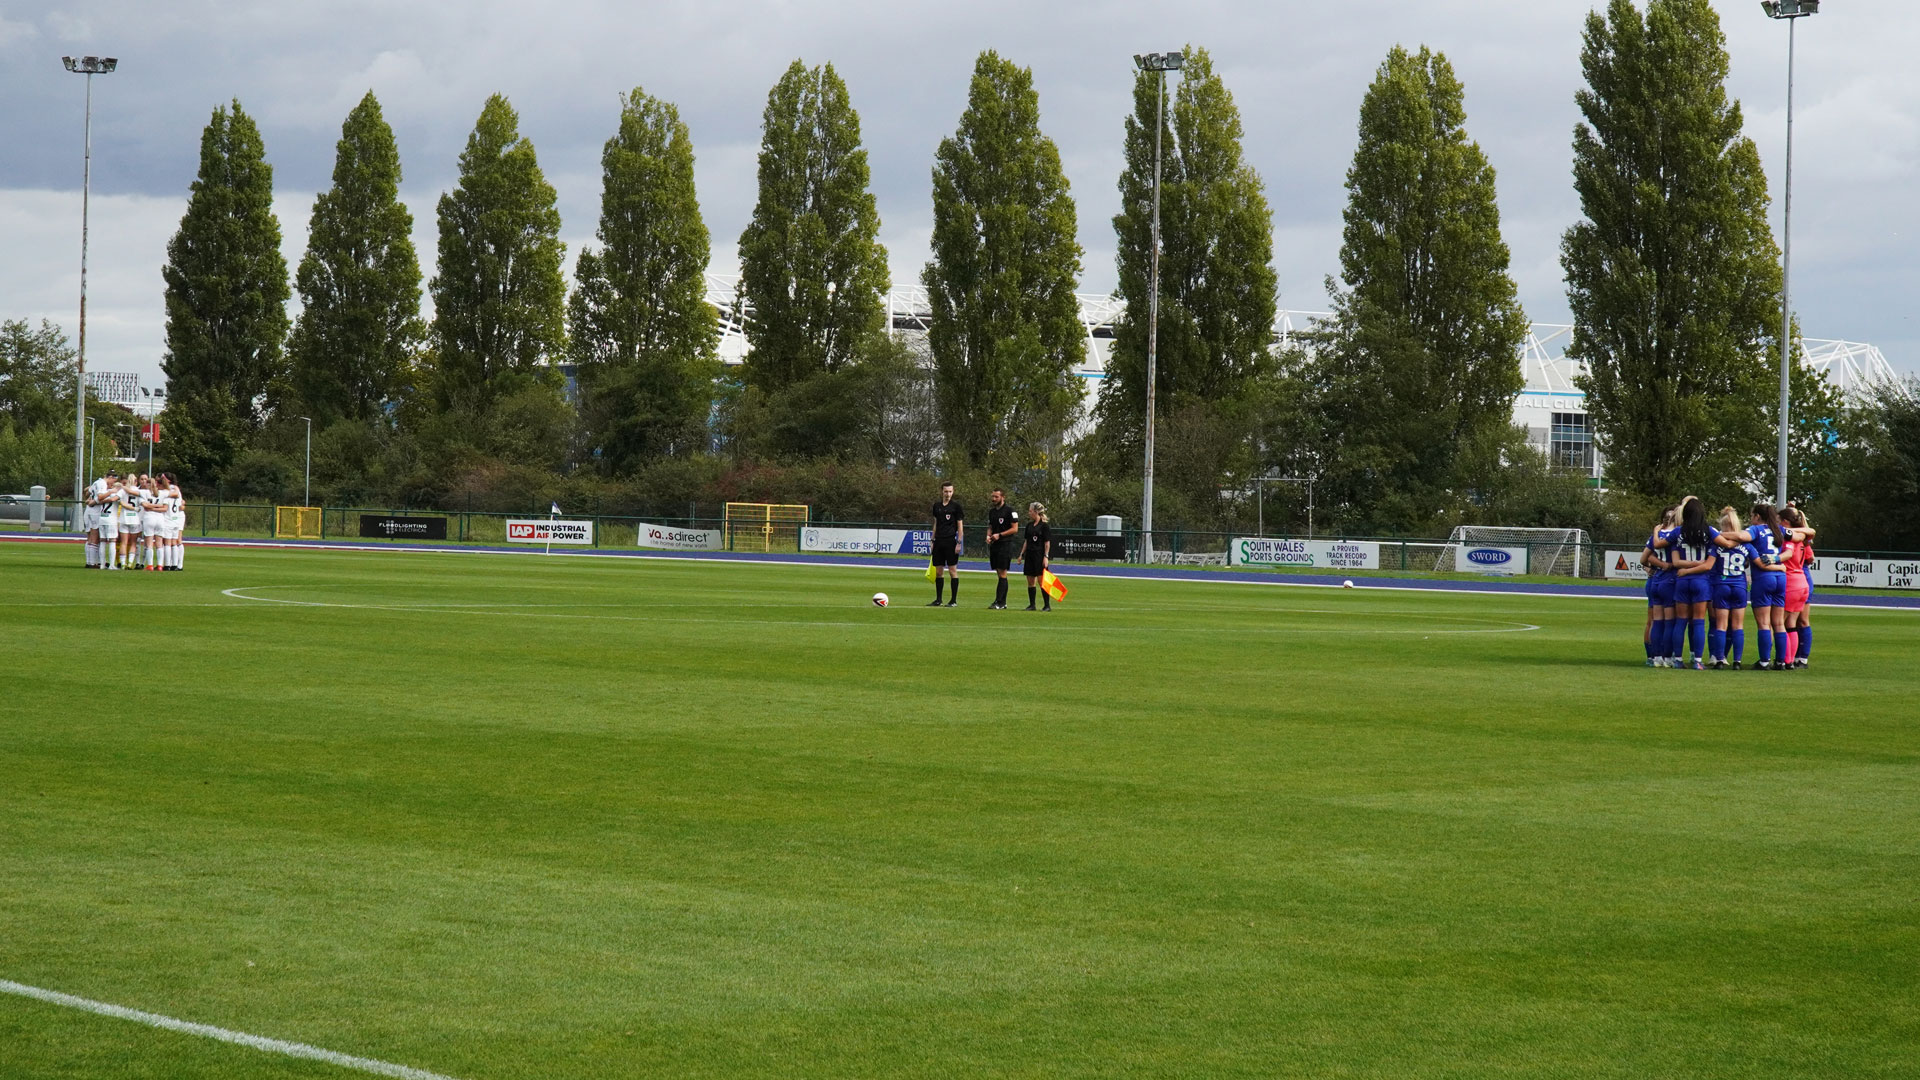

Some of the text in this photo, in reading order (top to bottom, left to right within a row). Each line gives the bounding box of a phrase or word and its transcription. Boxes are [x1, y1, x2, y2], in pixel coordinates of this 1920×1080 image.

[1554, 399, 1585, 411] CLU
[128, 496, 136, 507] 5
[511, 525, 533, 537] IAP
[536, 524, 587, 532] INDUSTRIAL
[553, 532, 584, 540] POWER
[912, 531, 933, 541] BUIL
[850, 542, 860, 550] OF
[863, 543, 893, 552] SPORT
[912, 546, 928, 554] FOR
[1274, 542, 1305, 553] WALES
[1681, 543, 1706, 562] 10
[1274, 553, 1314, 565] GROUNDS
[1471, 552, 1506, 562] SWORD
[1630, 561, 1646, 571] Fle
[1720, 552, 1746, 577] 18
[1835, 560, 1873, 574] Capital
[1887, 563, 1920, 577] Capit
[1887, 576, 1913, 587] Law
